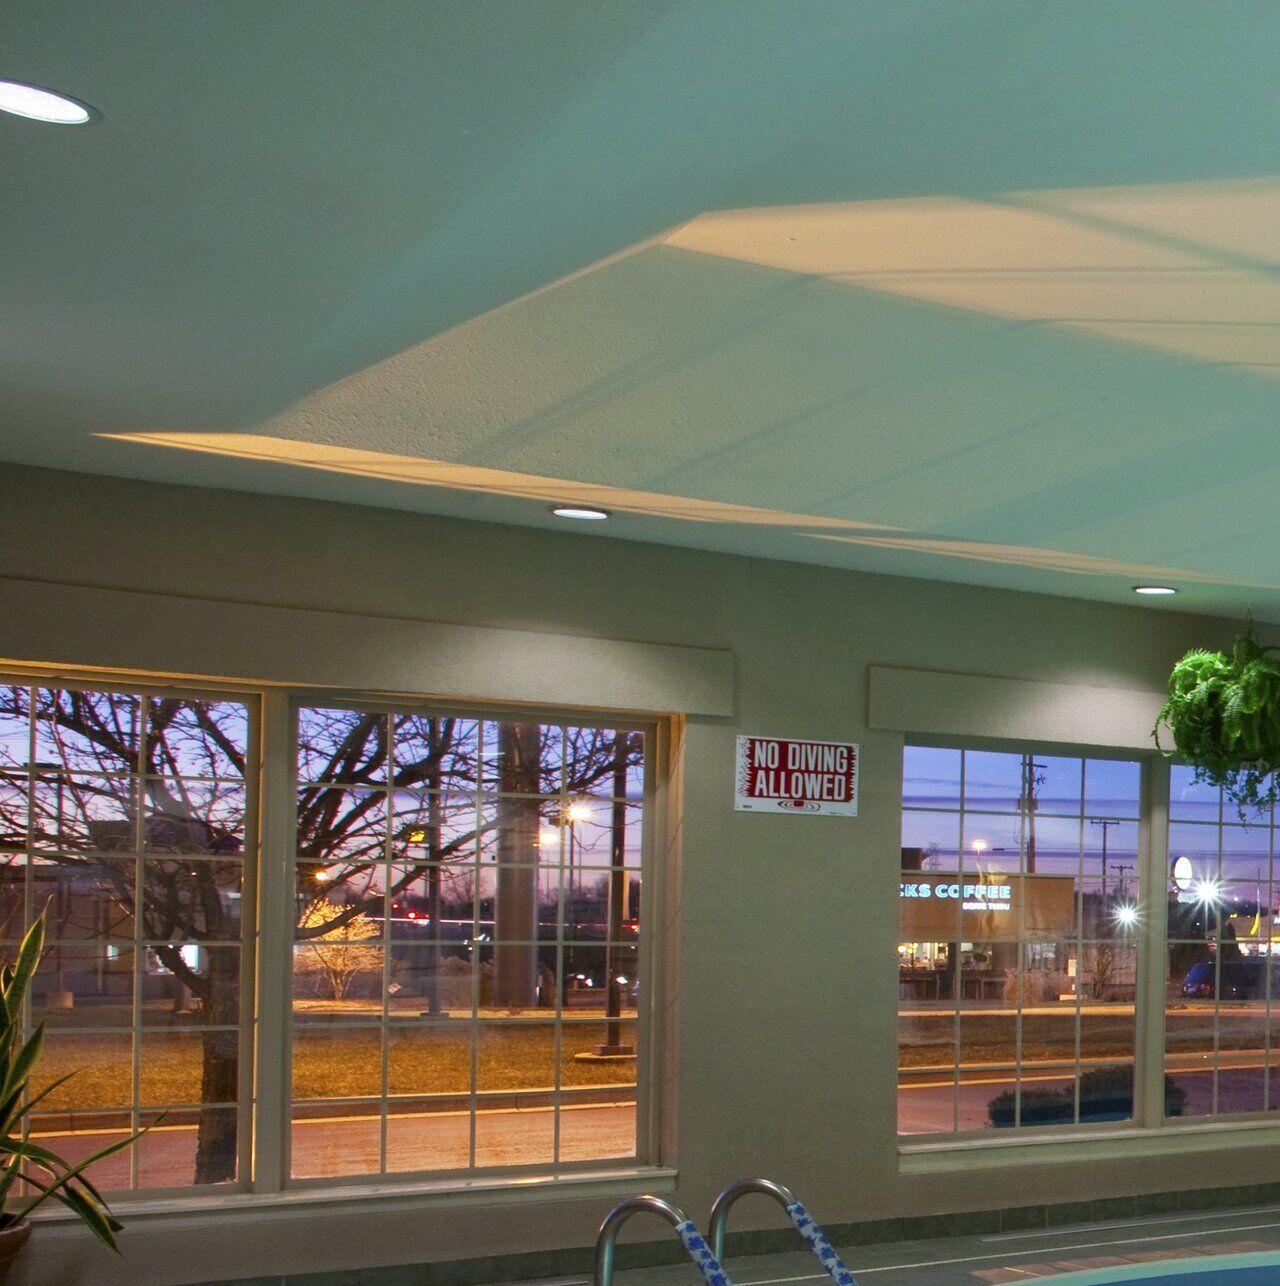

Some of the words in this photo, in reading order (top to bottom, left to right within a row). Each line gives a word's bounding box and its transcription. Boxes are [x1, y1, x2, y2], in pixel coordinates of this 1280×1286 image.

[754, 740, 779, 769] NO
[787, 743, 848, 774] DIVING
[754, 770, 846, 801] ALLOWED
[900, 883, 931, 898] KS
[935, 883, 1011, 899] COFFEE
